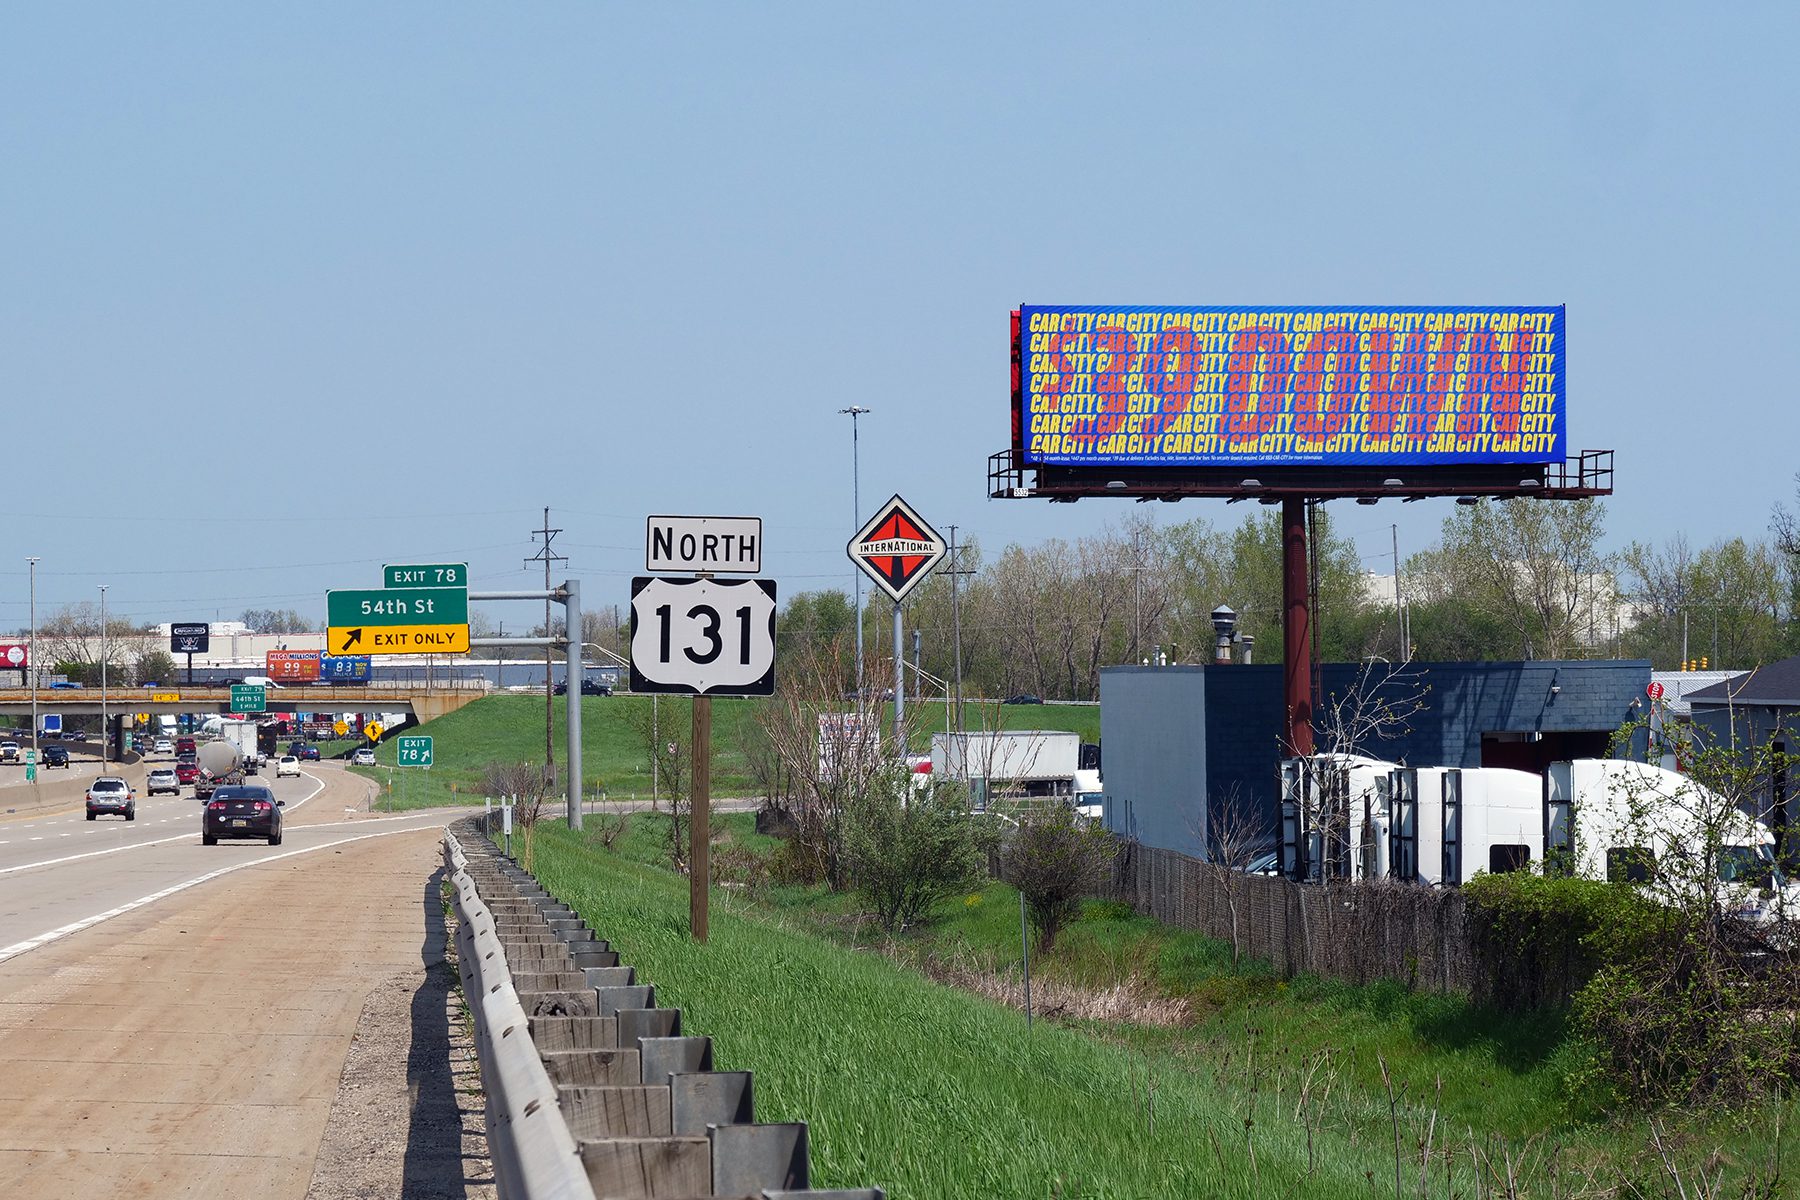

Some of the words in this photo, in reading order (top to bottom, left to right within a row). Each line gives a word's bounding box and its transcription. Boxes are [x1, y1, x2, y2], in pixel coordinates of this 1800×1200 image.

[652, 527, 756, 563] NORTH
[860, 540, 934, 553] INTERNATIONAL
[394, 571, 426, 583] EXIT
[435, 569, 457, 583] 78
[361, 599, 407, 615] 54th
[415, 598, 434, 614] St
[374, 633, 408, 645] EXIT
[414, 632, 455, 645] ONLY
[655, 604, 752, 666] 131
[1651, 682, 1660, 698] STOP
[402, 750, 418, 760] 78
